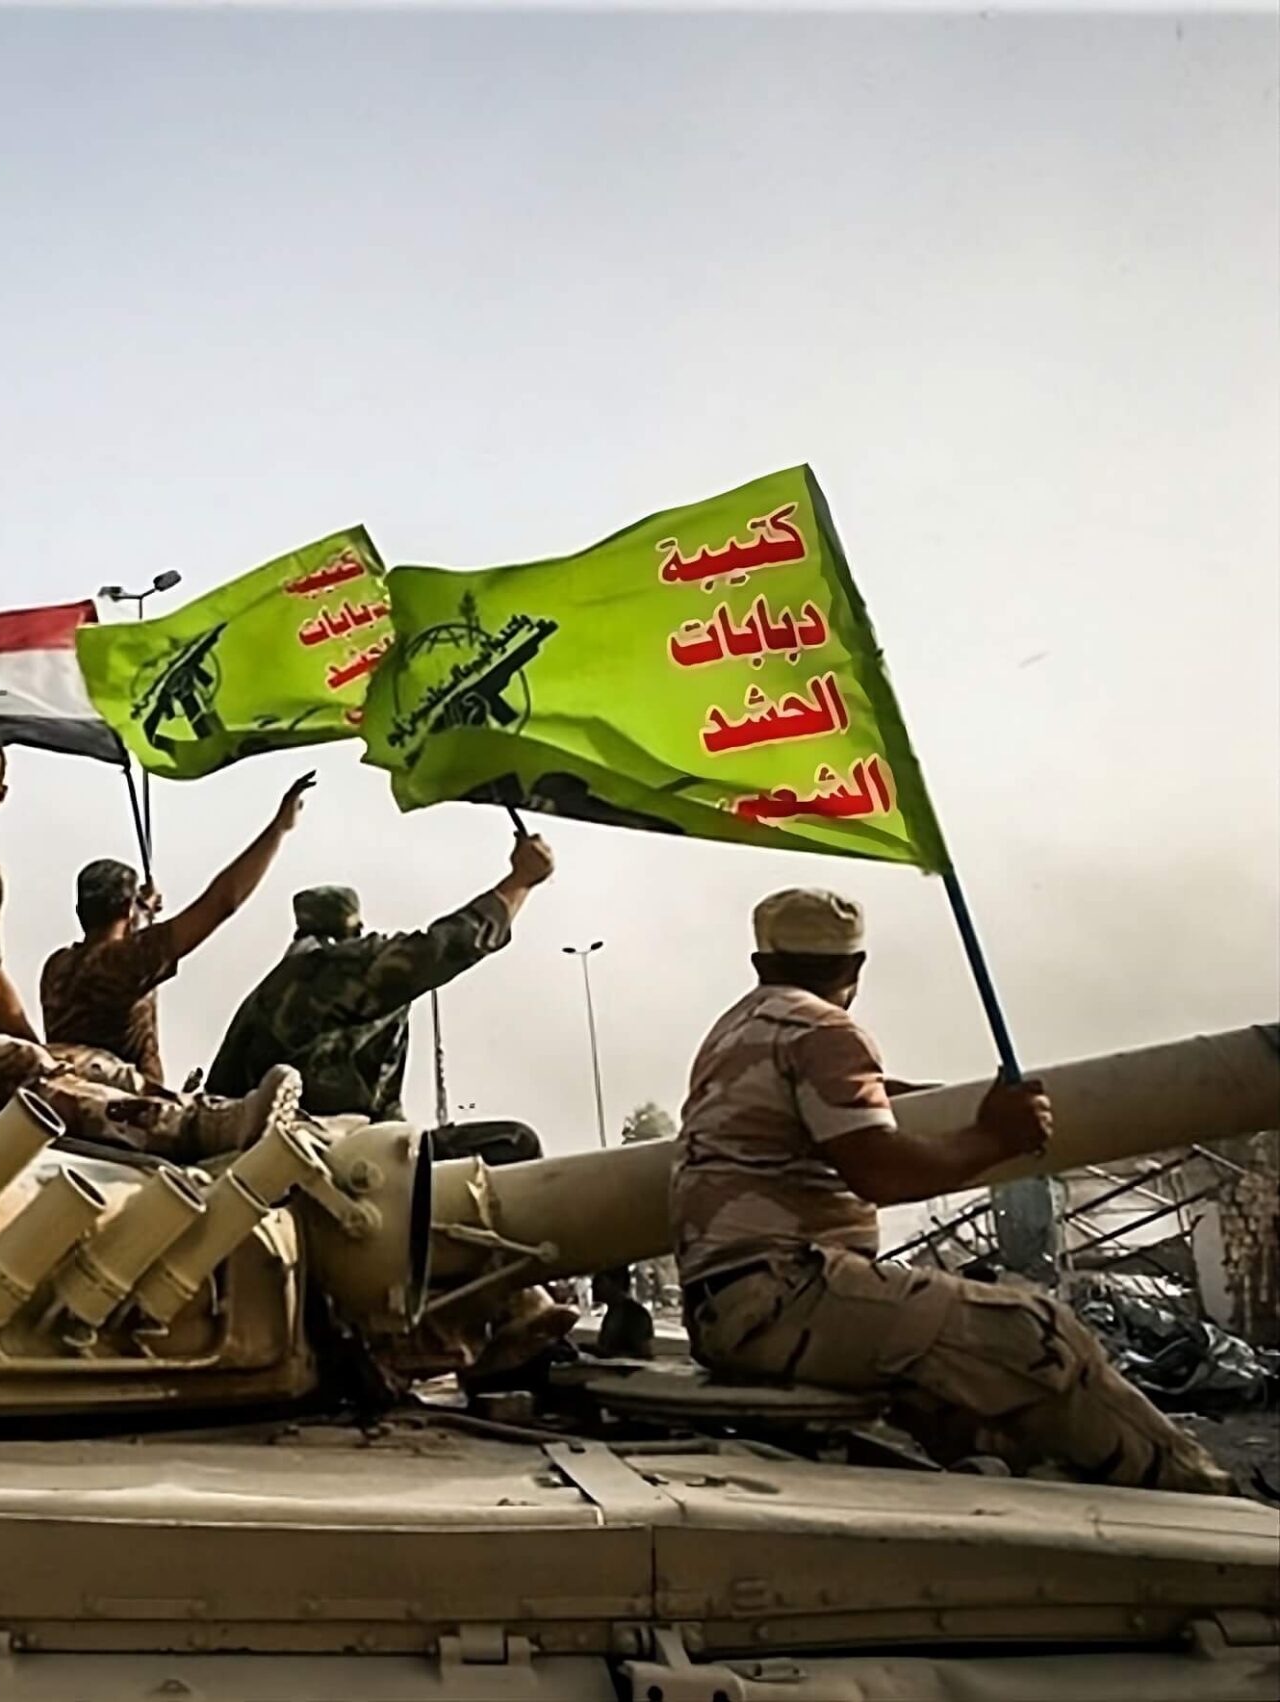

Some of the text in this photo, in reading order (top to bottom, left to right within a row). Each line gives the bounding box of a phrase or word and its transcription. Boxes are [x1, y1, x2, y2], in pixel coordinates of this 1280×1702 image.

[657, 502, 806, 592] كتيبة
[668, 594, 827, 668] دبابات
[700, 672, 849, 755] الحشد
